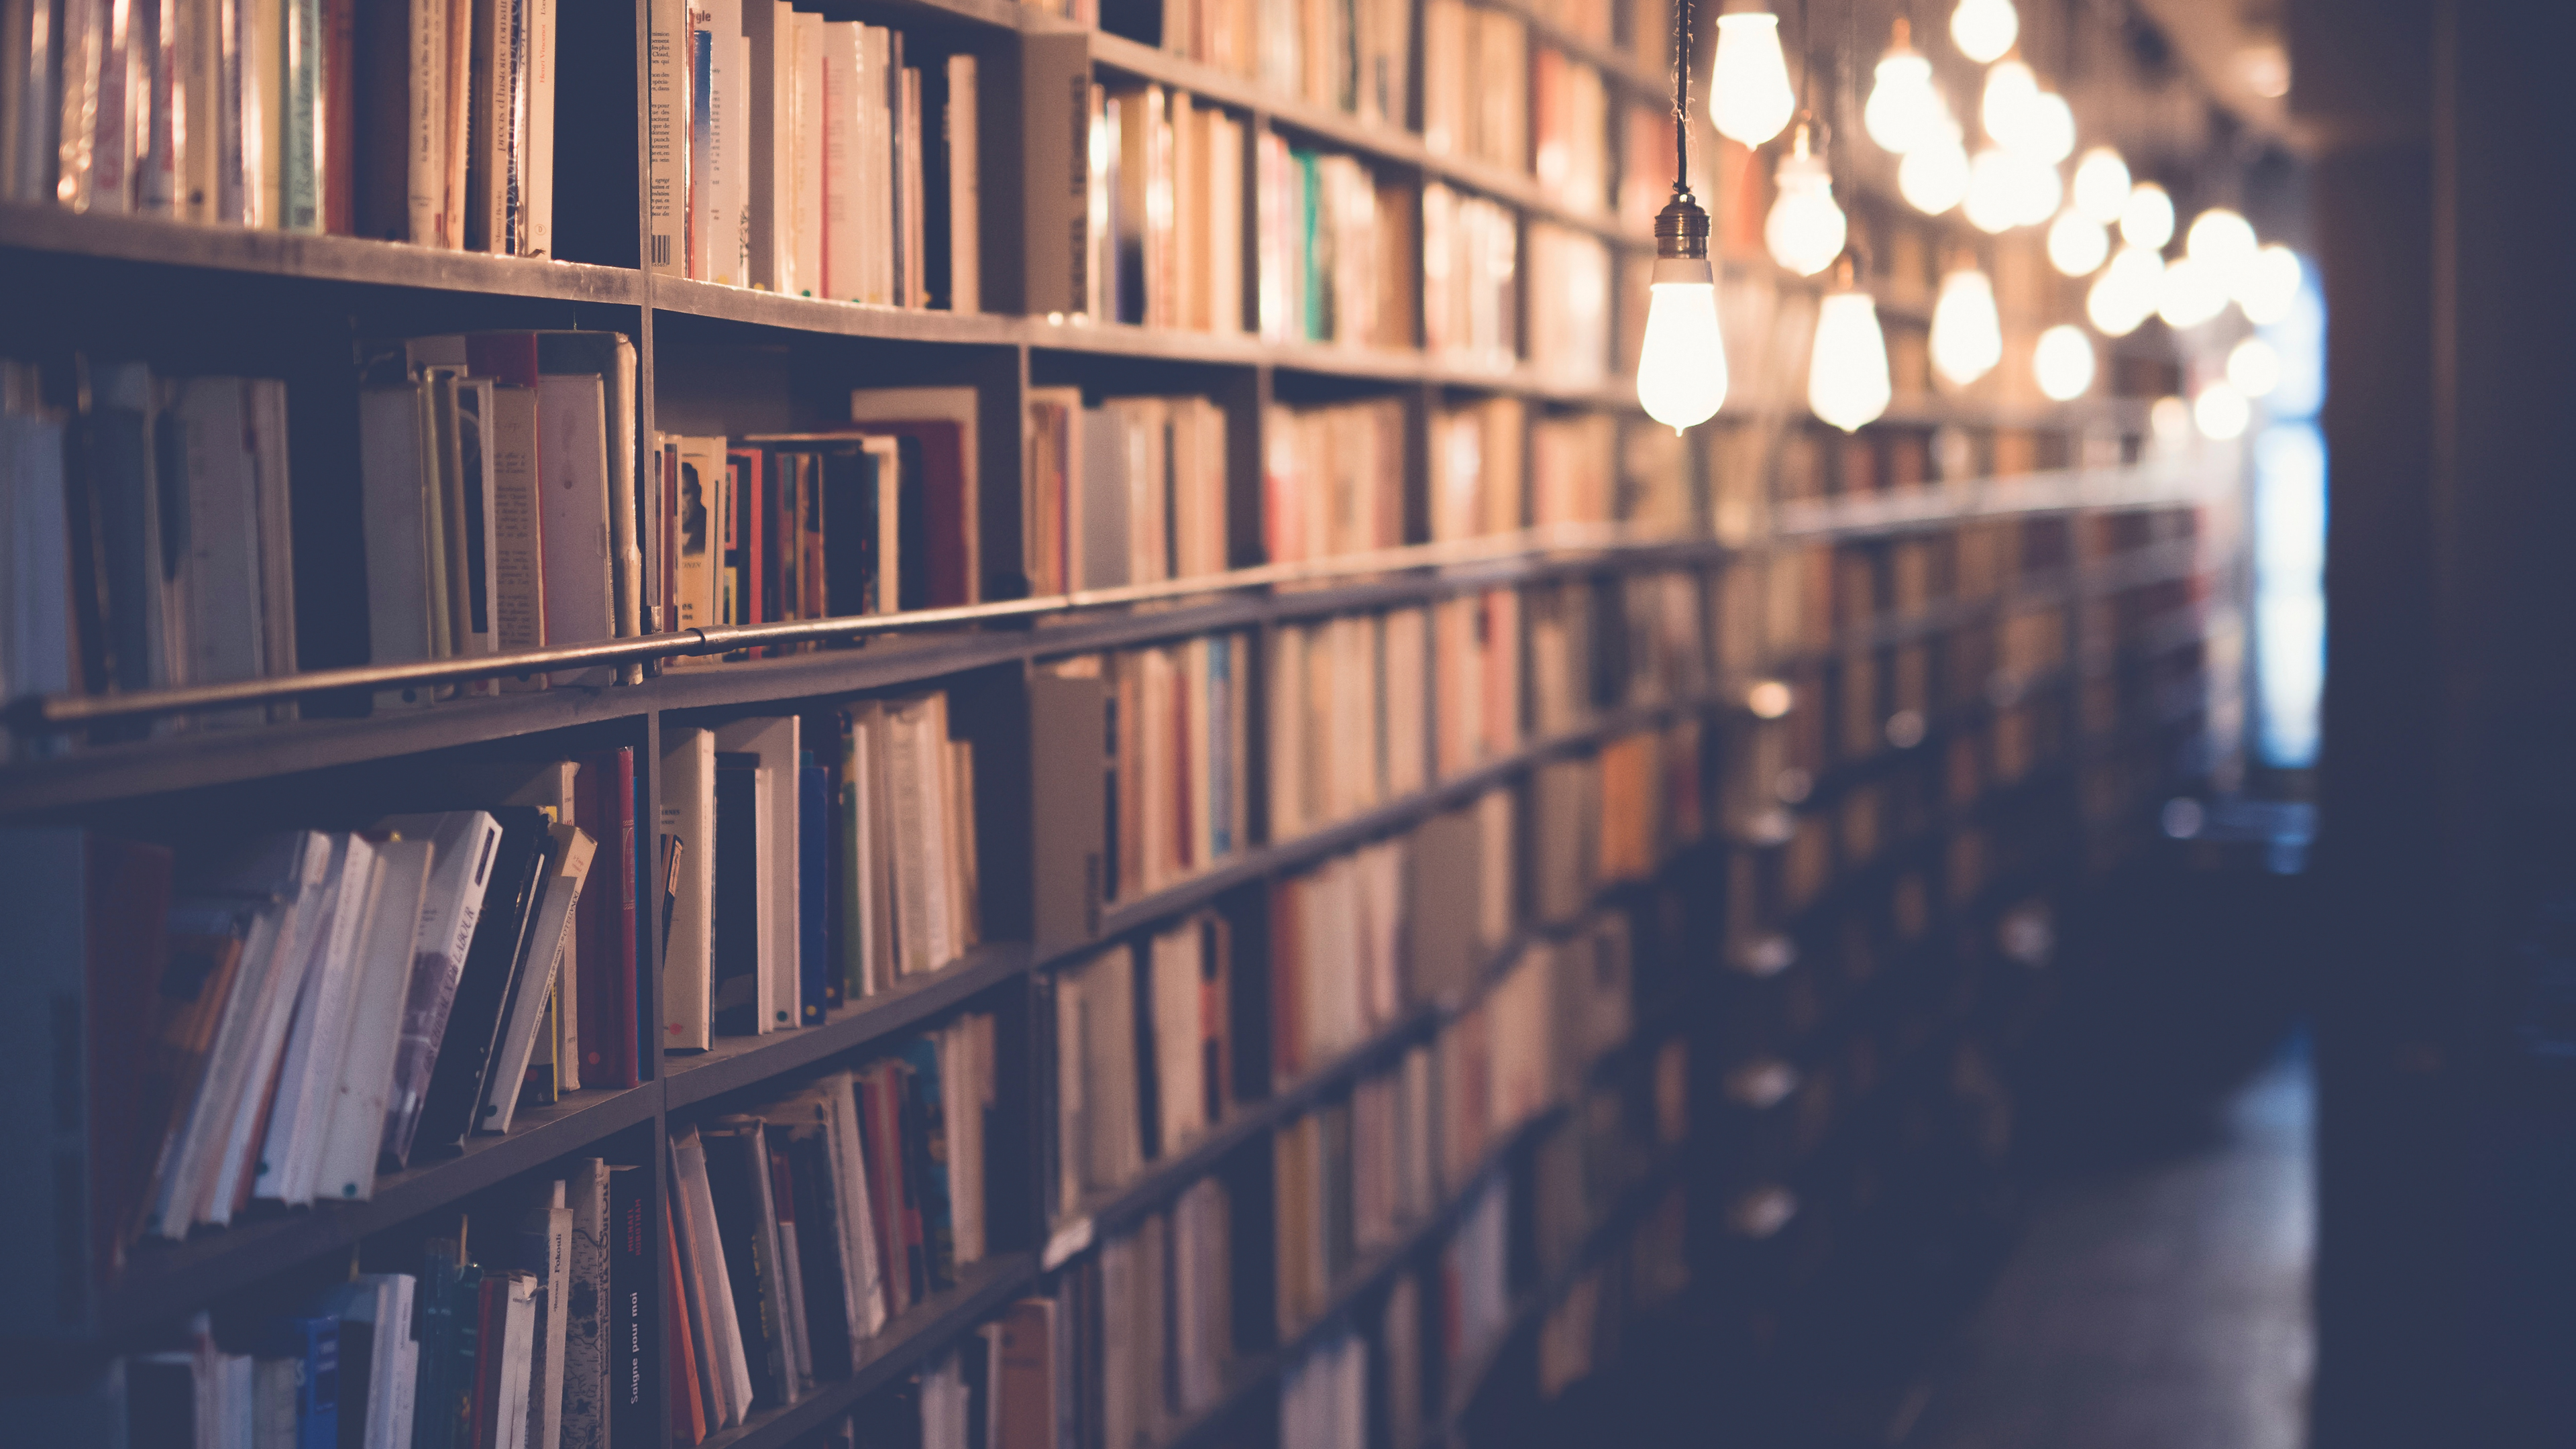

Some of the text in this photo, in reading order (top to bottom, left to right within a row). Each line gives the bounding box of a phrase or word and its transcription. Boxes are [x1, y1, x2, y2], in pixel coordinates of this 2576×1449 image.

[454, 906, 475, 963] LABOUR
[562, 890, 580, 936] DONATELLO
[554, 1233, 562, 1273] Fokouli
[634, 1198, 642, 1256] ROBOTHAM
[629, 1291, 640, 1405] Saigne pour moi
